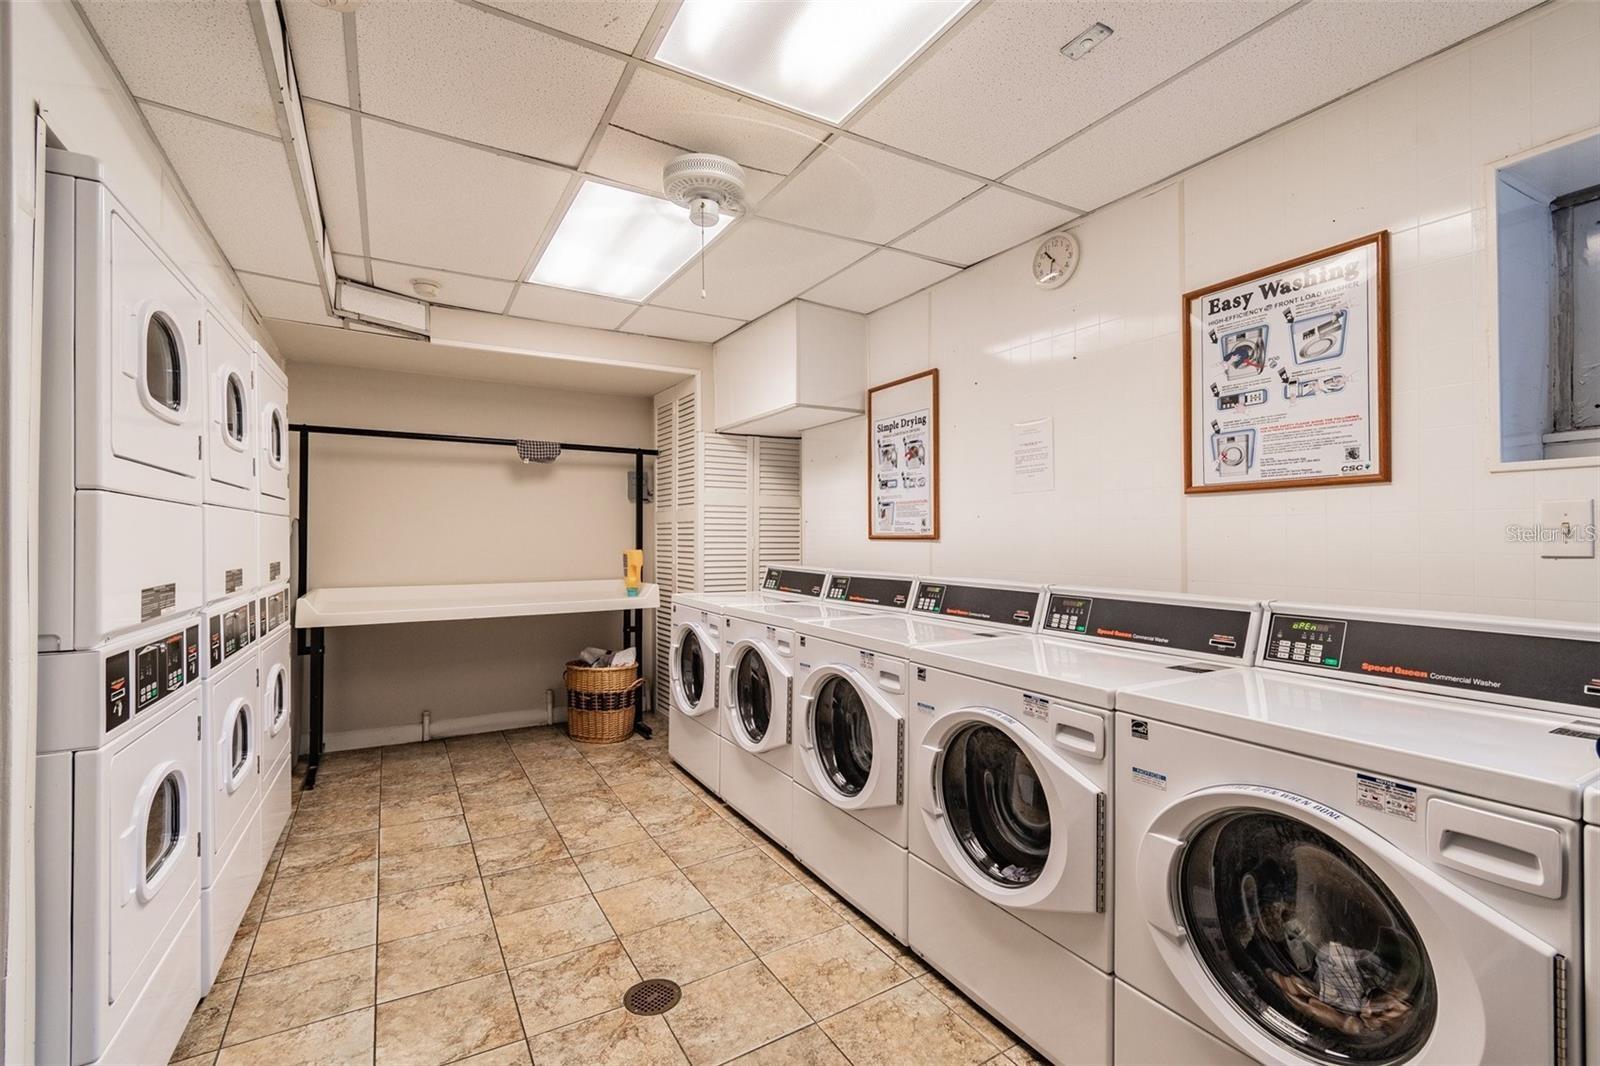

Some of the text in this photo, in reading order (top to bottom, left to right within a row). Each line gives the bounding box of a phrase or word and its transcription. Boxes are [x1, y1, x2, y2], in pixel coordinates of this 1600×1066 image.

[1208, 260, 1360, 316] Easy Washing
[1208, 307, 1263, 327] HIGH-EFFICIENCY
[1274, 297, 1298, 309] FRONT
[1300, 291, 1322, 302] LOAD
[1324, 280, 1360, 297] WASHER
[877, 416, 926, 434] Simple Drying
[1341, 464, 1364, 473] CSC
[1361, 662, 1502, 689] Speed Queen Commercial Washer
